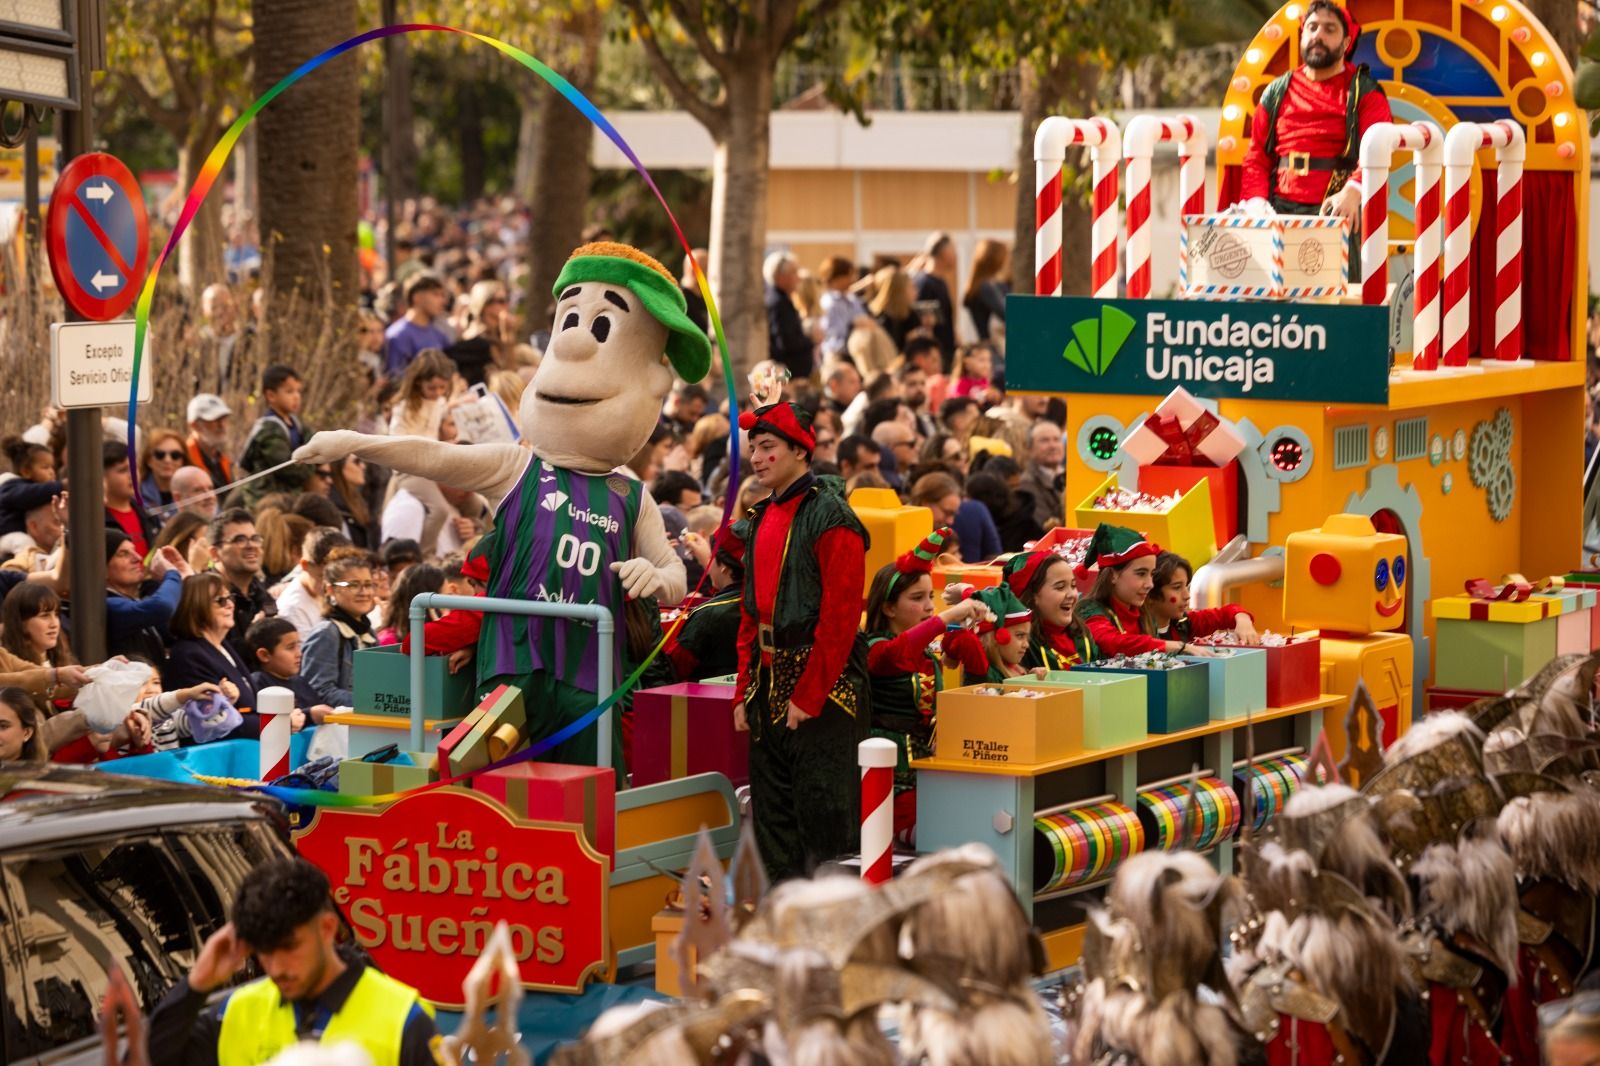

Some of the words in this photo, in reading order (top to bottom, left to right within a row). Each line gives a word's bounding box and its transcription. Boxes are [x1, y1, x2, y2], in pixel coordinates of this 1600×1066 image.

[1146, 312, 1326, 350] Fundación
[86, 344, 123, 359] Excepto
[70, 370, 107, 385] Servicio
[111, 368, 132, 382] Ofici
[1146, 347, 1275, 392] Unicaja
[568, 503, 619, 533] Unicaja
[556, 533, 601, 577] 00
[375, 693, 385, 702] El
[387, 694, 411, 704] Talle
[383, 703, 411, 713] Piñer
[964, 739, 974, 749] El
[976, 740, 1009, 751] Taller
[973, 750, 1008, 761] Piñero
[437, 822, 474, 849] La
[344, 837, 568, 904] Fábrica
[334, 886, 350, 903] e
[350, 898, 564, 963] Sueños
